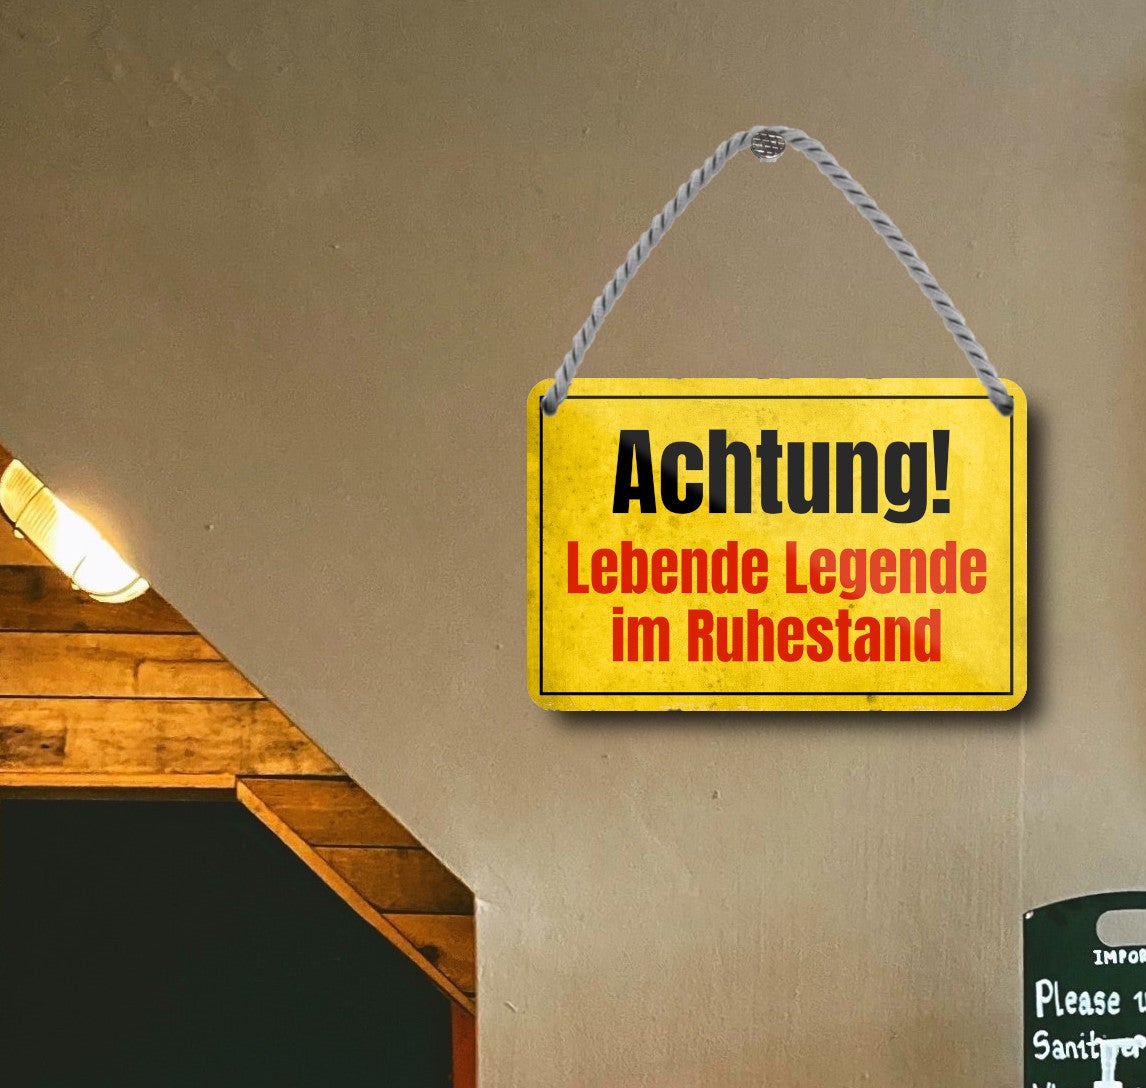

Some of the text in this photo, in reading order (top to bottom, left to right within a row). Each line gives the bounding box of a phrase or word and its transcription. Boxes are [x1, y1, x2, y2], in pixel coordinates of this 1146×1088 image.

[612, 429, 950, 524] Achtung!
[567, 540, 988, 601] Lebende Legende
[612, 606, 942, 663] im Ruhestand
[1035, 978, 1120, 1018] Please
